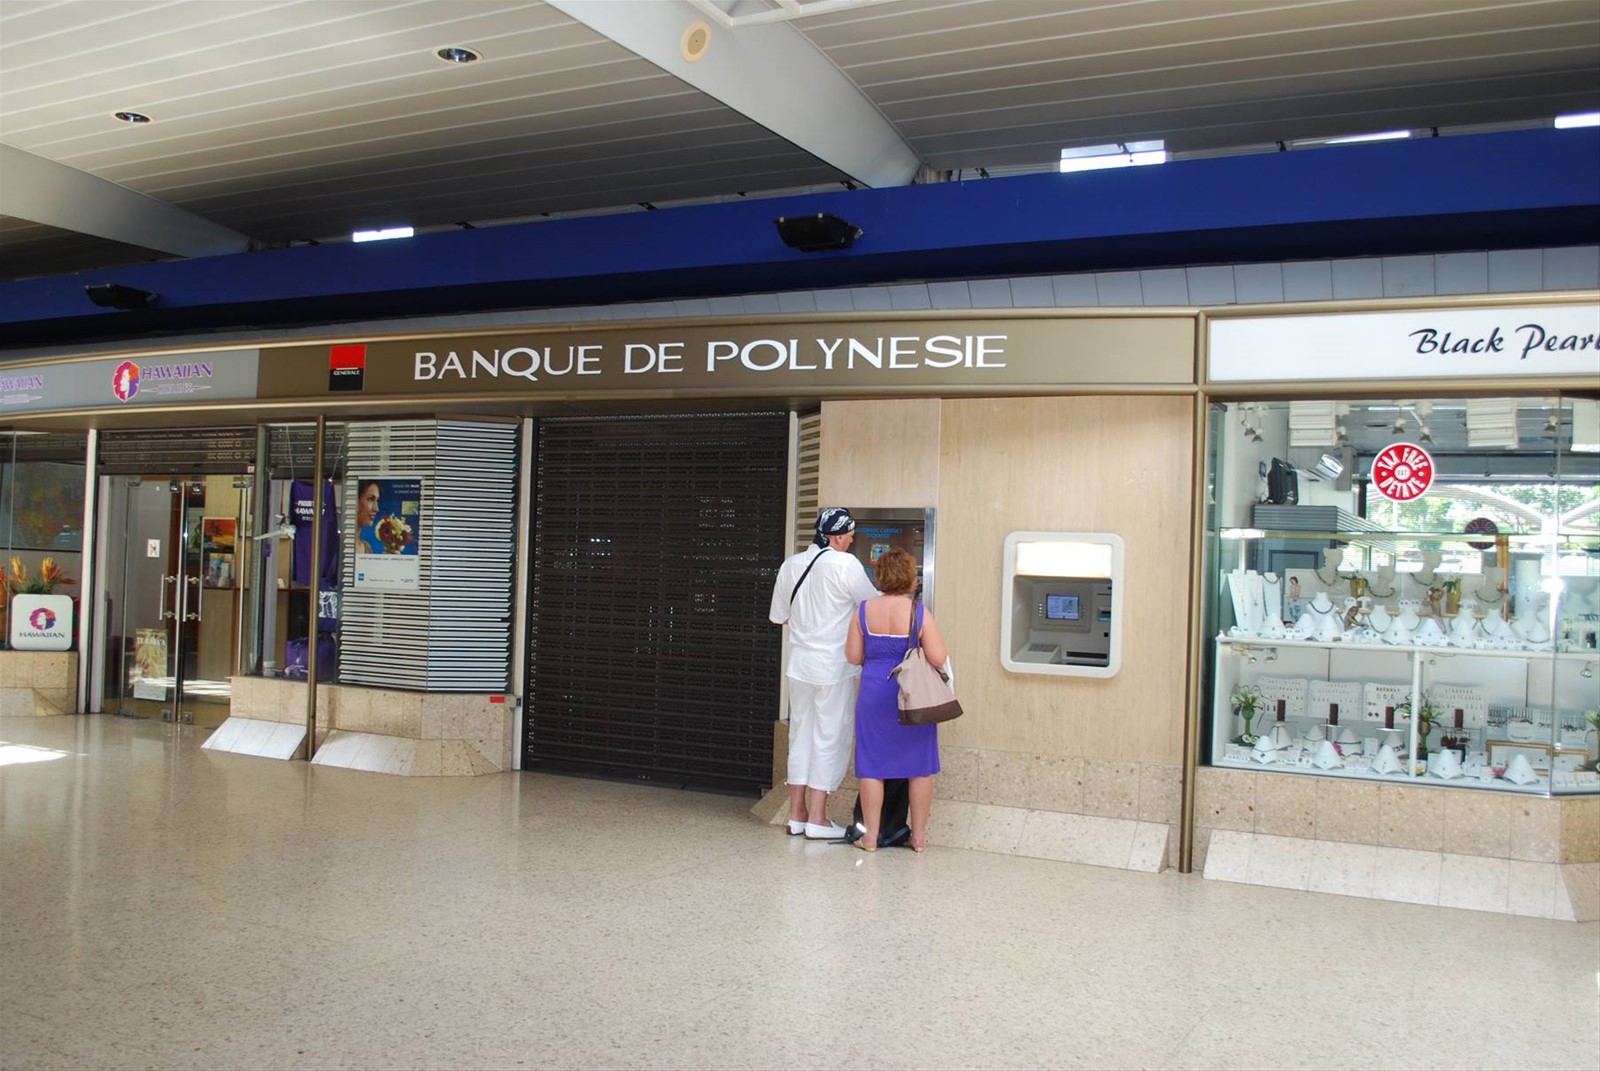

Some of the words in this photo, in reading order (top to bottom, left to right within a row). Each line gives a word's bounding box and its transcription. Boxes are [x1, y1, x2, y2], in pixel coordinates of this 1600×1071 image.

[1408, 326, 1505, 354] Black
[141, 362, 212, 381] HAWAIIAN
[413, 344, 603, 382] BANQUE
[623, 342, 685, 374] DE
[706, 335, 1008, 372] POLYNESIE
[1377, 450, 1401, 471] TAX
[1402, 447, 1428, 471] FREE
